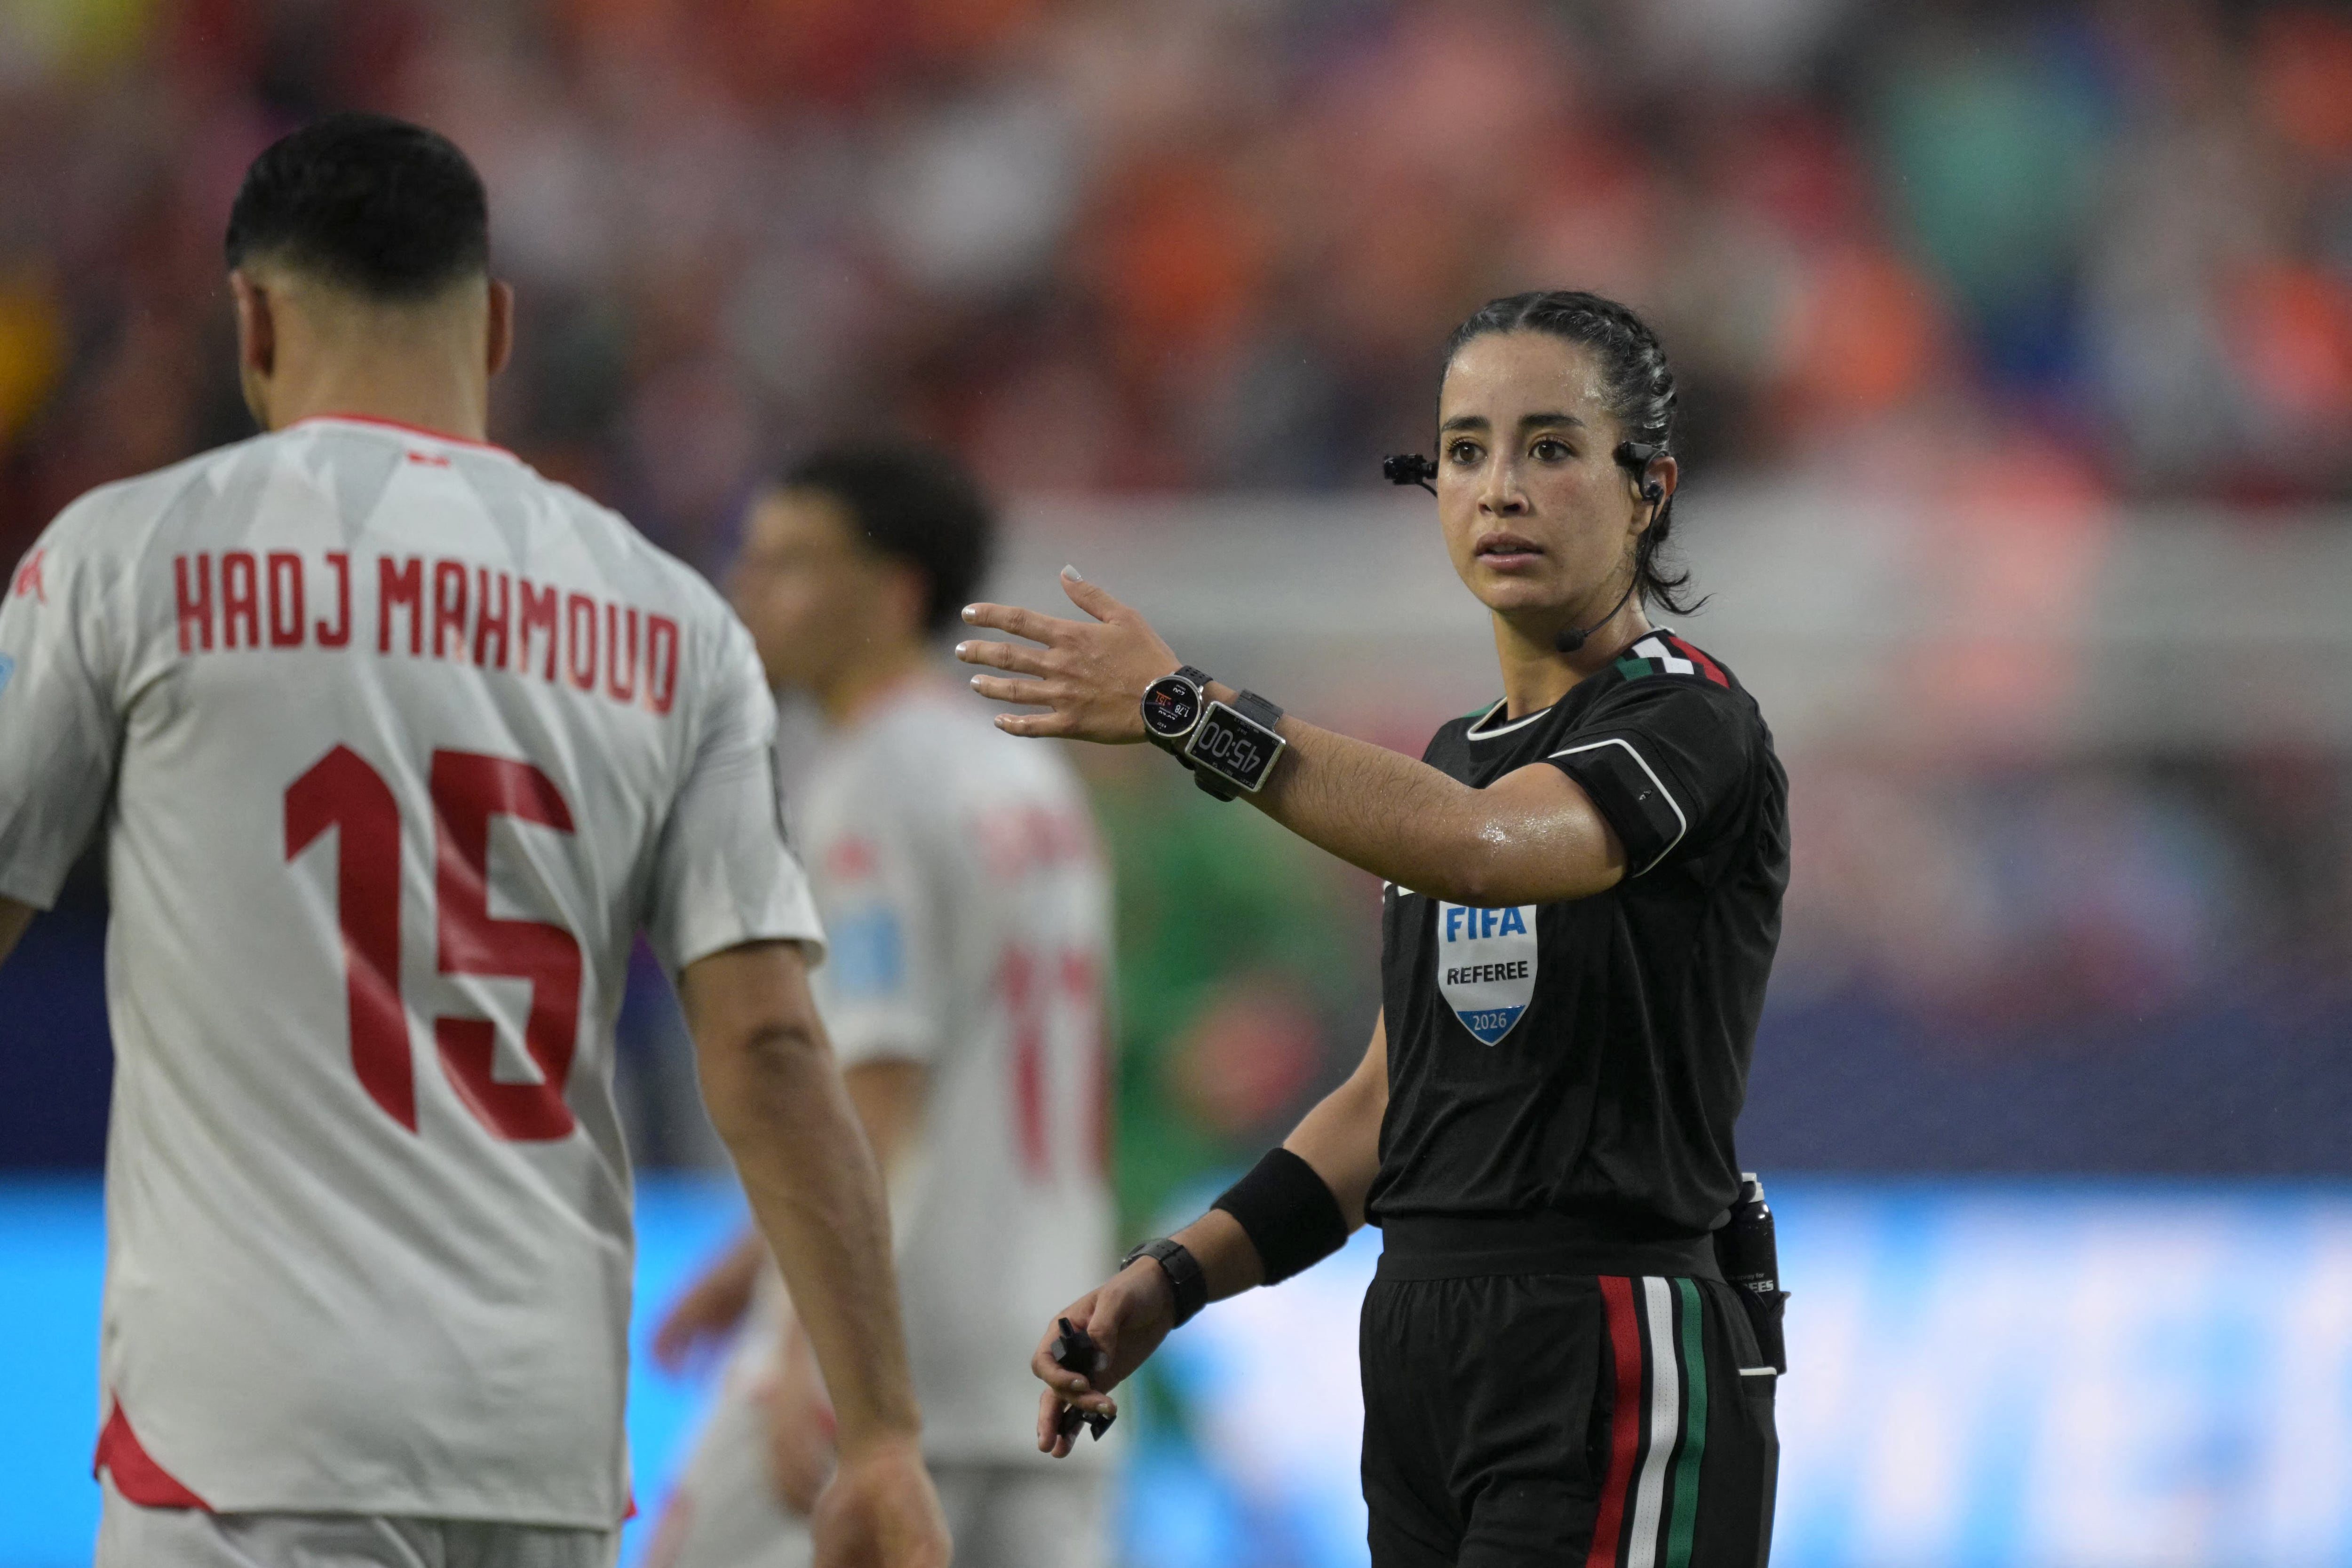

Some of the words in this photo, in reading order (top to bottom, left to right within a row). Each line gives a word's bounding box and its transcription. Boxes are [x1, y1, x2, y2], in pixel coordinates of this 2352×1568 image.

[175, 552, 351, 656] HADJ
[379, 553, 679, 716] MAHMOUD
[1175, 705, 1189, 717] 1.78
[1199, 722, 1260, 773] 45:00
[1447, 907, 1527, 942] FIFA
[285, 742, 583, 1143] 15
[1447, 961, 1528, 985] REFEREE
[1473, 1013, 1507, 1030] 2026
[1743, 1280, 1774, 1293] EES
